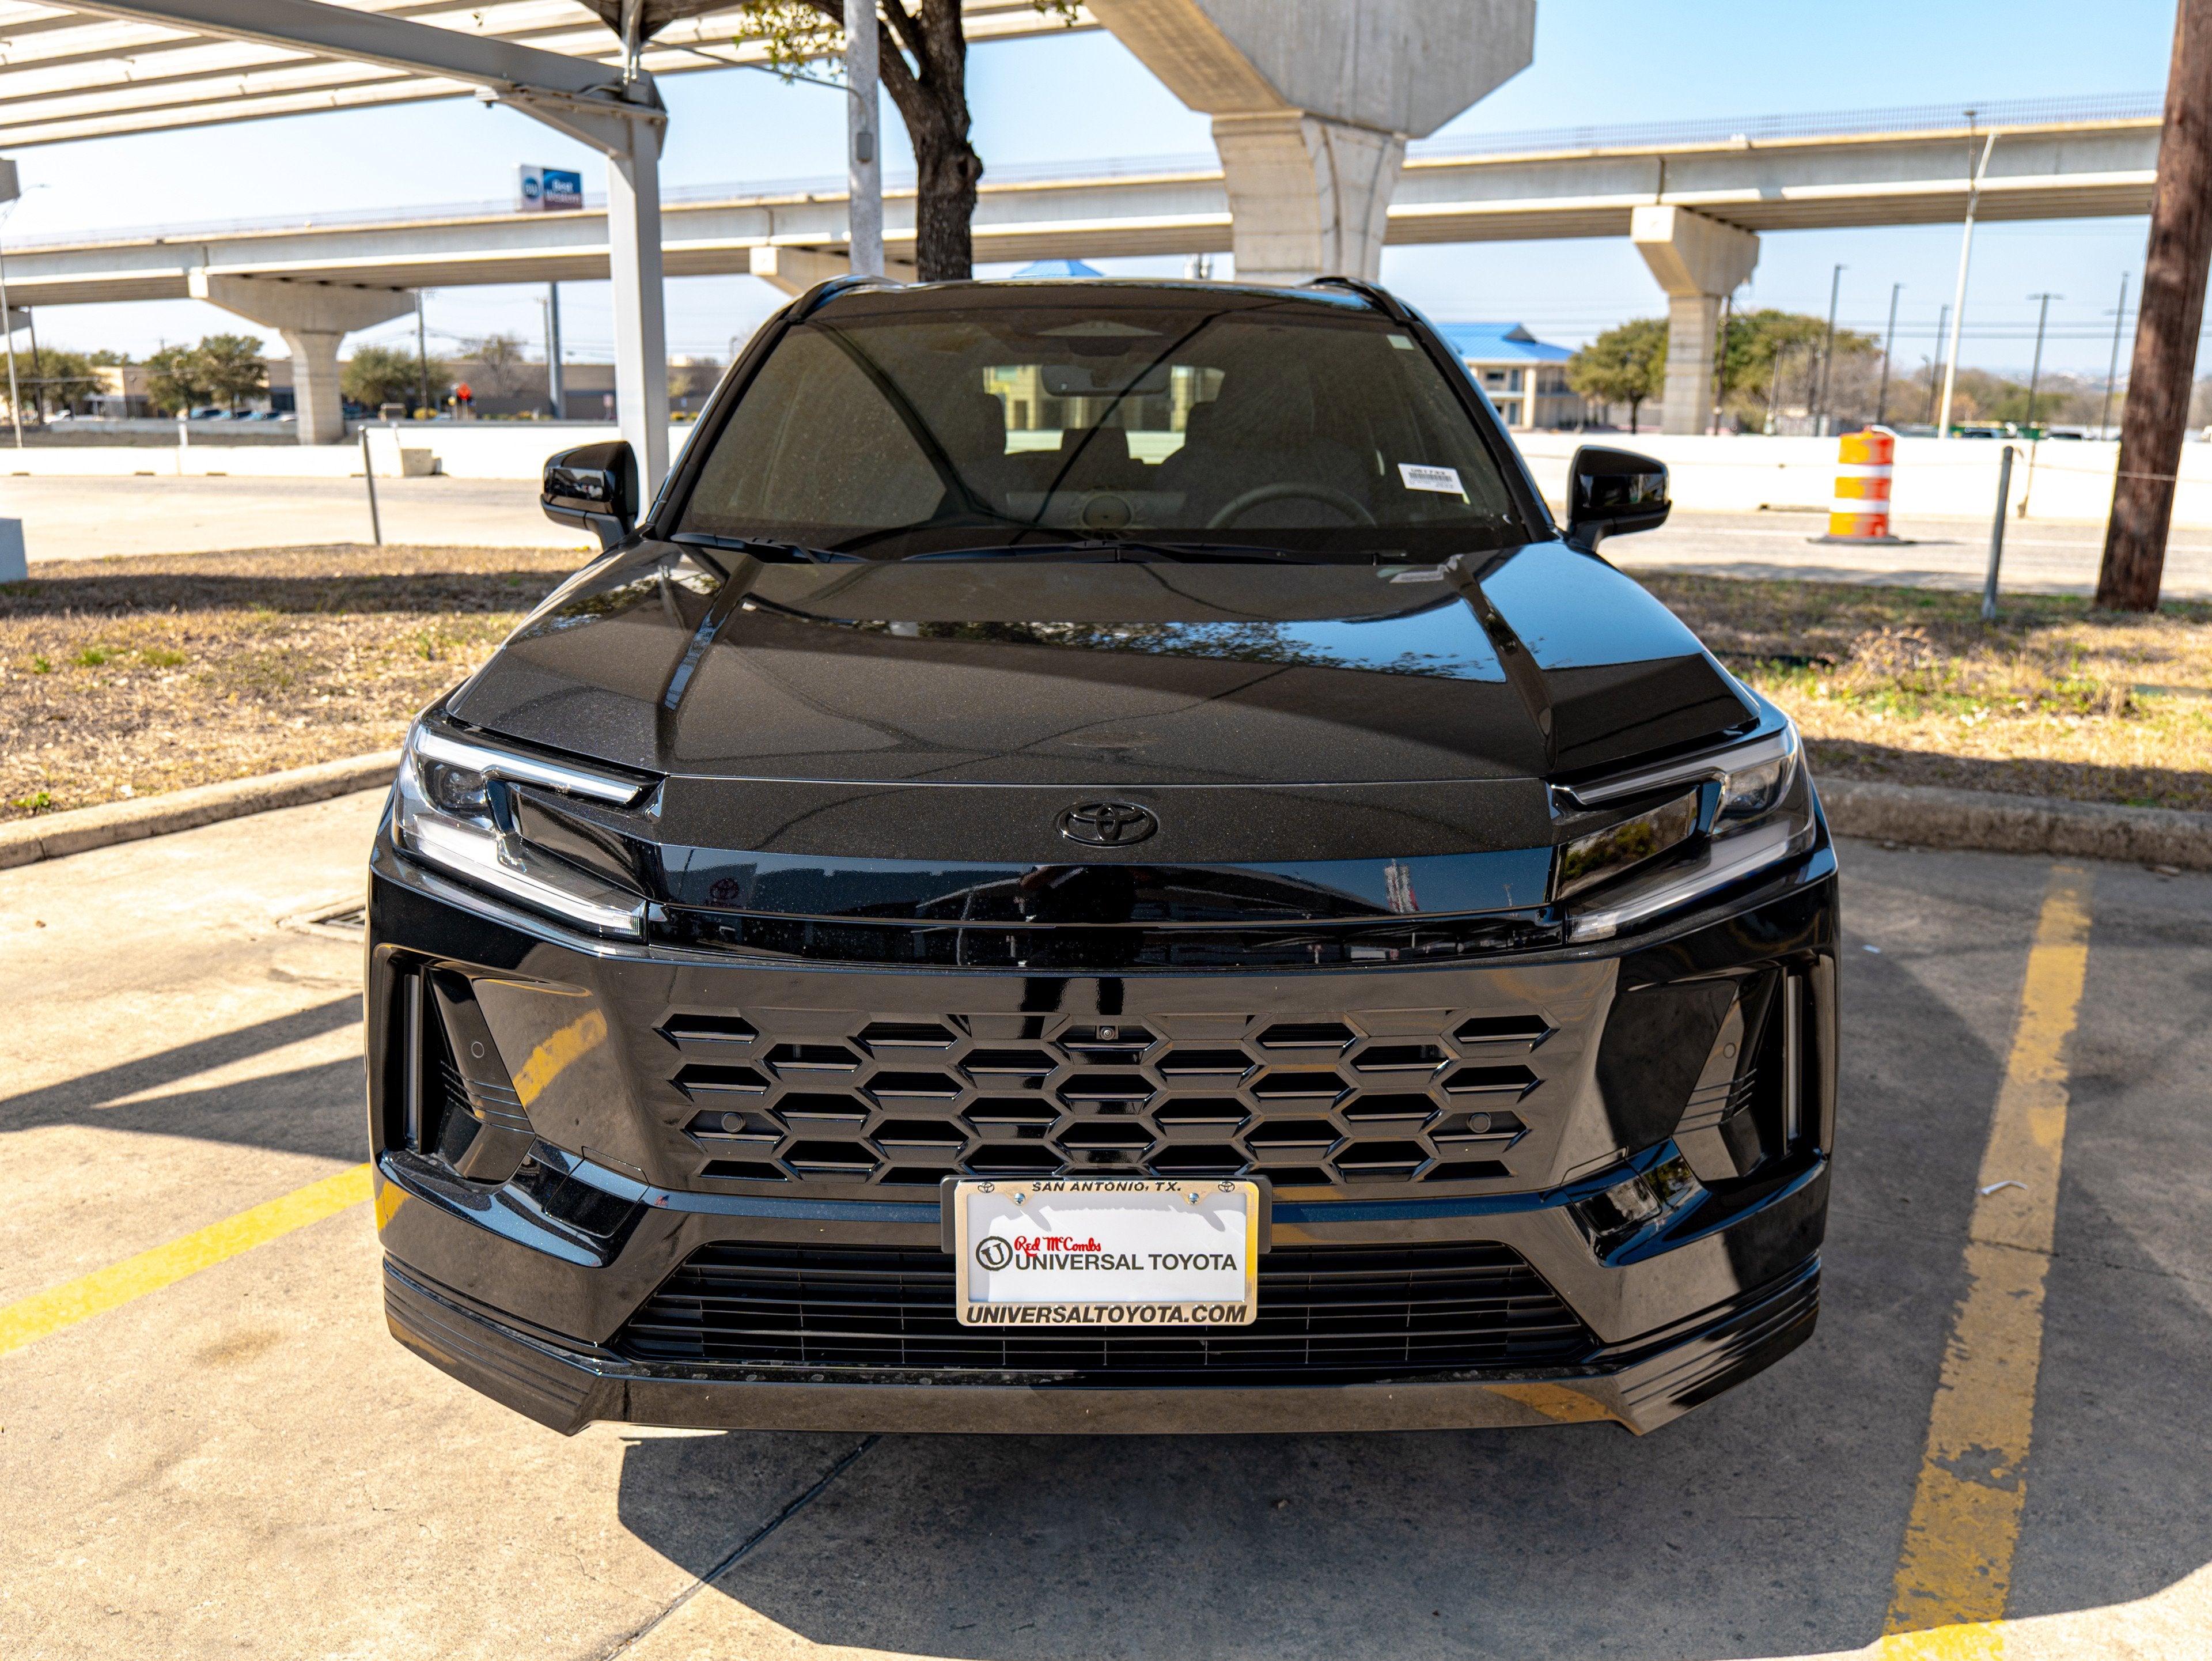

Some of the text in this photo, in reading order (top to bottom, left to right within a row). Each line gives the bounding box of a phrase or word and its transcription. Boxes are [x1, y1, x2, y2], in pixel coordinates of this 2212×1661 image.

[1032, 1182, 1181, 1191] SAN ANTONIO, TX.
[1014, 1236, 1101, 1257] Red McCombs
[1016, 1254, 1237, 1270] UNIVERSAL TOYOTA
[967, 1304, 1247, 1323] UNIVERSALTOYOTA.COM
